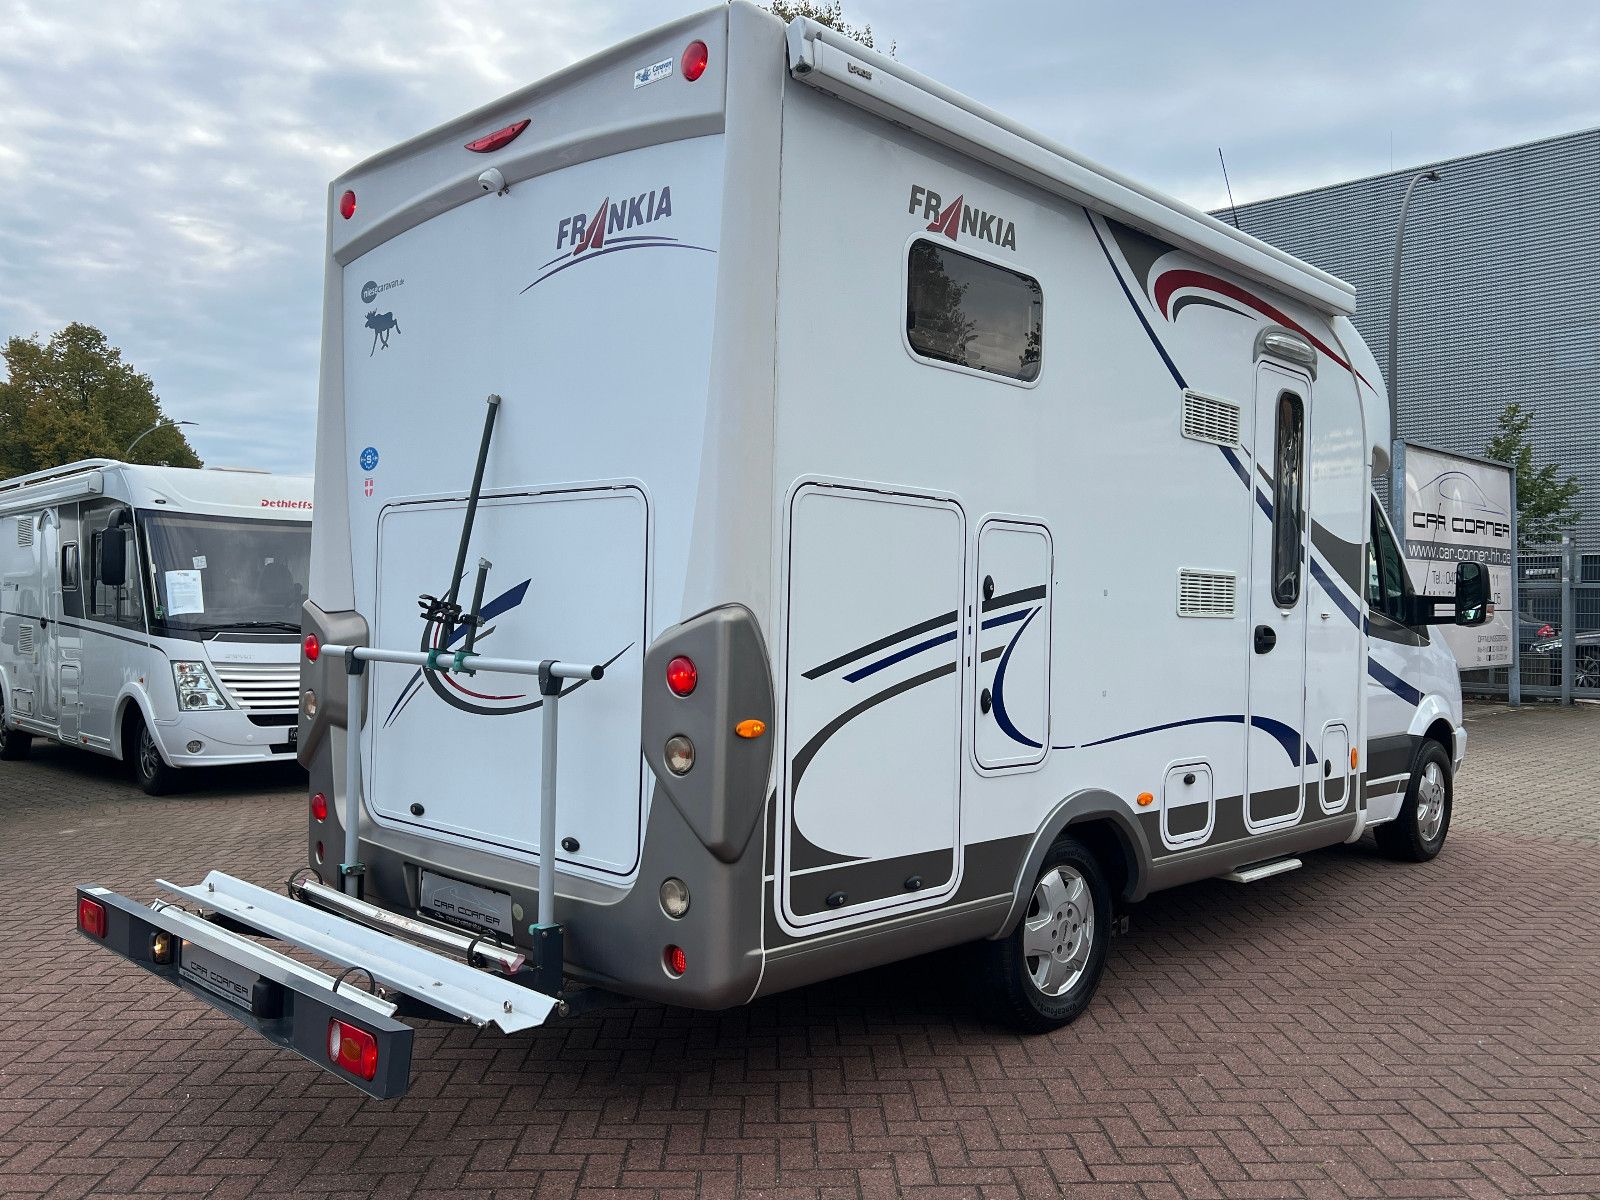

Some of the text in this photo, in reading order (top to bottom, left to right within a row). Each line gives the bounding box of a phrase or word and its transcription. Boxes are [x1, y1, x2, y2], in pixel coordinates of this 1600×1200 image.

[556, 186, 672, 256] FRANKIA
[908, 185, 1016, 251] FRANKIA
[261, 499, 313, 510] Dethleffs
[1413, 512, 1510, 538] CAR CORNER
[434, 899, 454, 912] CAR
[458, 907, 501, 926] CORNER
[190, 961, 208, 977] CAR
[210, 971, 249, 996] CORNER
